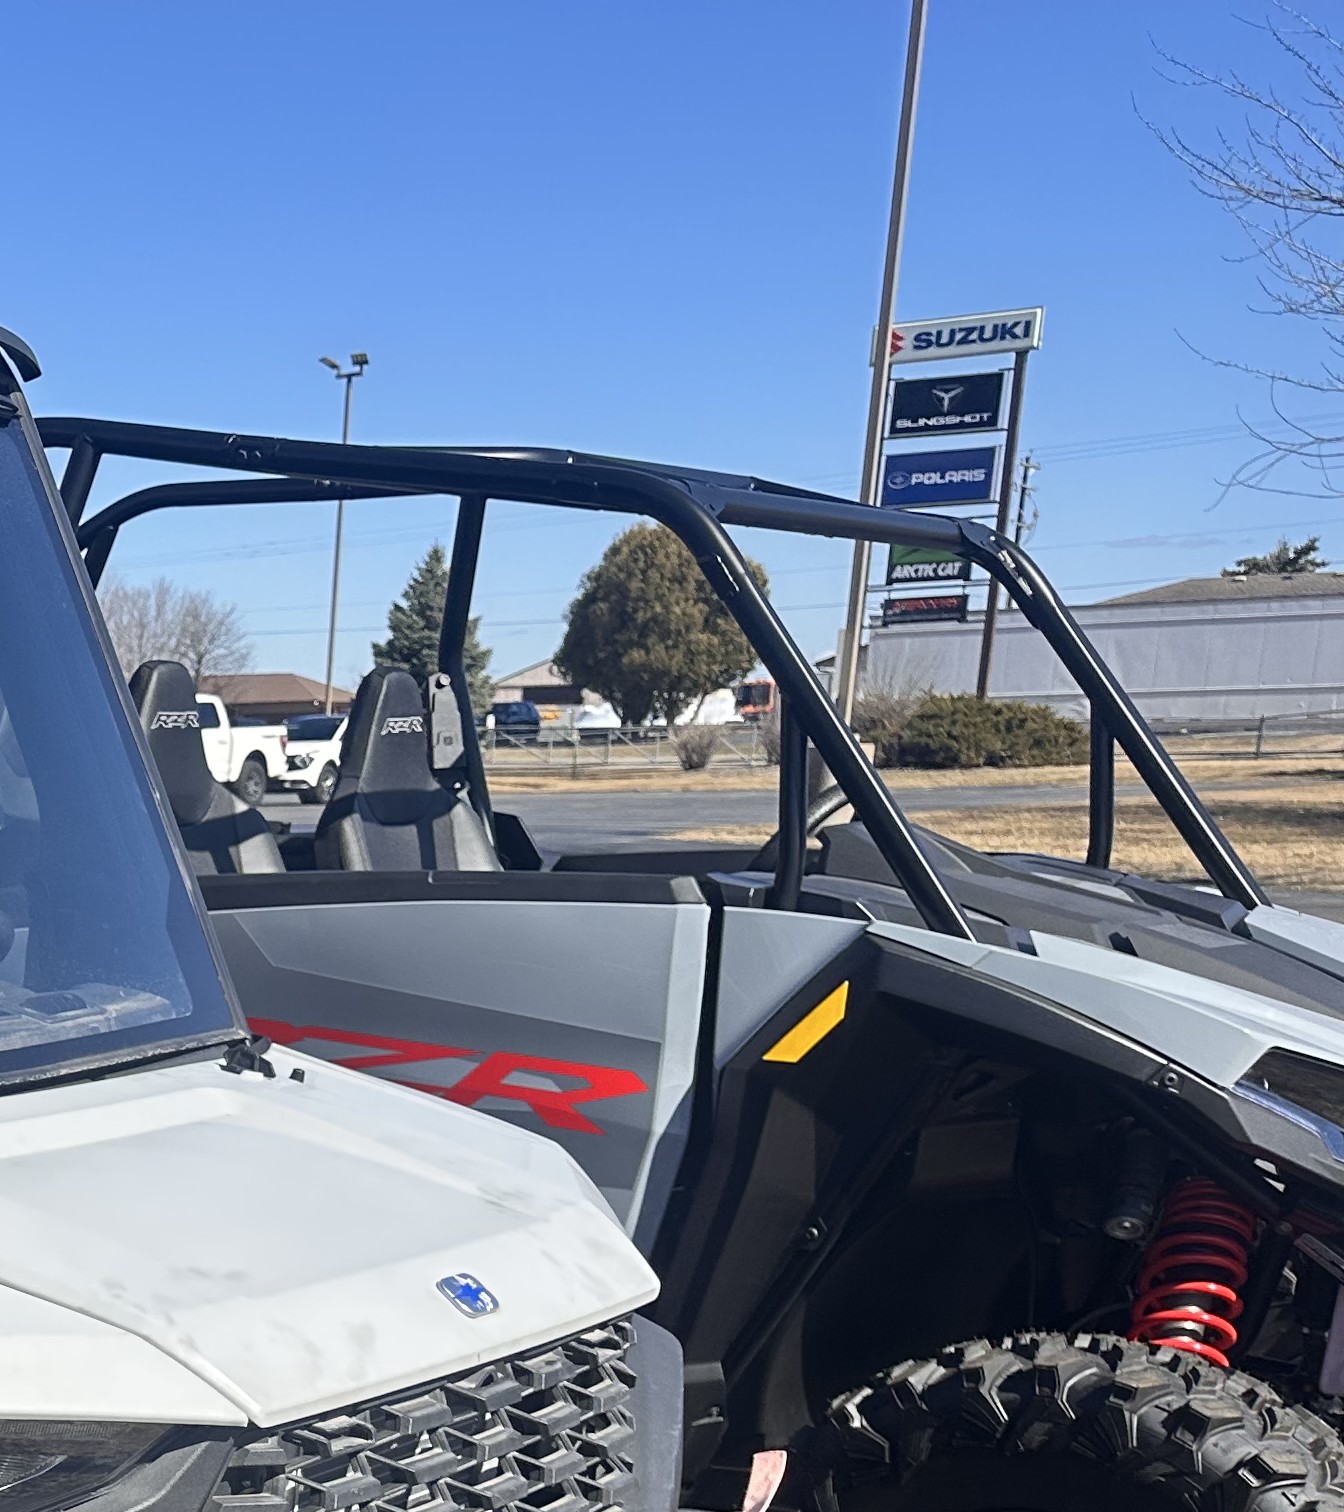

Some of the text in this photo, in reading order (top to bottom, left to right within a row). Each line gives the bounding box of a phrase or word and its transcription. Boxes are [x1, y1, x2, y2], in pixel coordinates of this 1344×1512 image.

[913, 320, 1032, 350] SUZUKI
[895, 412, 992, 429] SLINGSHOT
[910, 468, 986, 485] POLARIS
[891, 561, 963, 579] ARCTIC CAT
[150, 711, 200, 730] RZR
[380, 716, 424, 736] RZR
